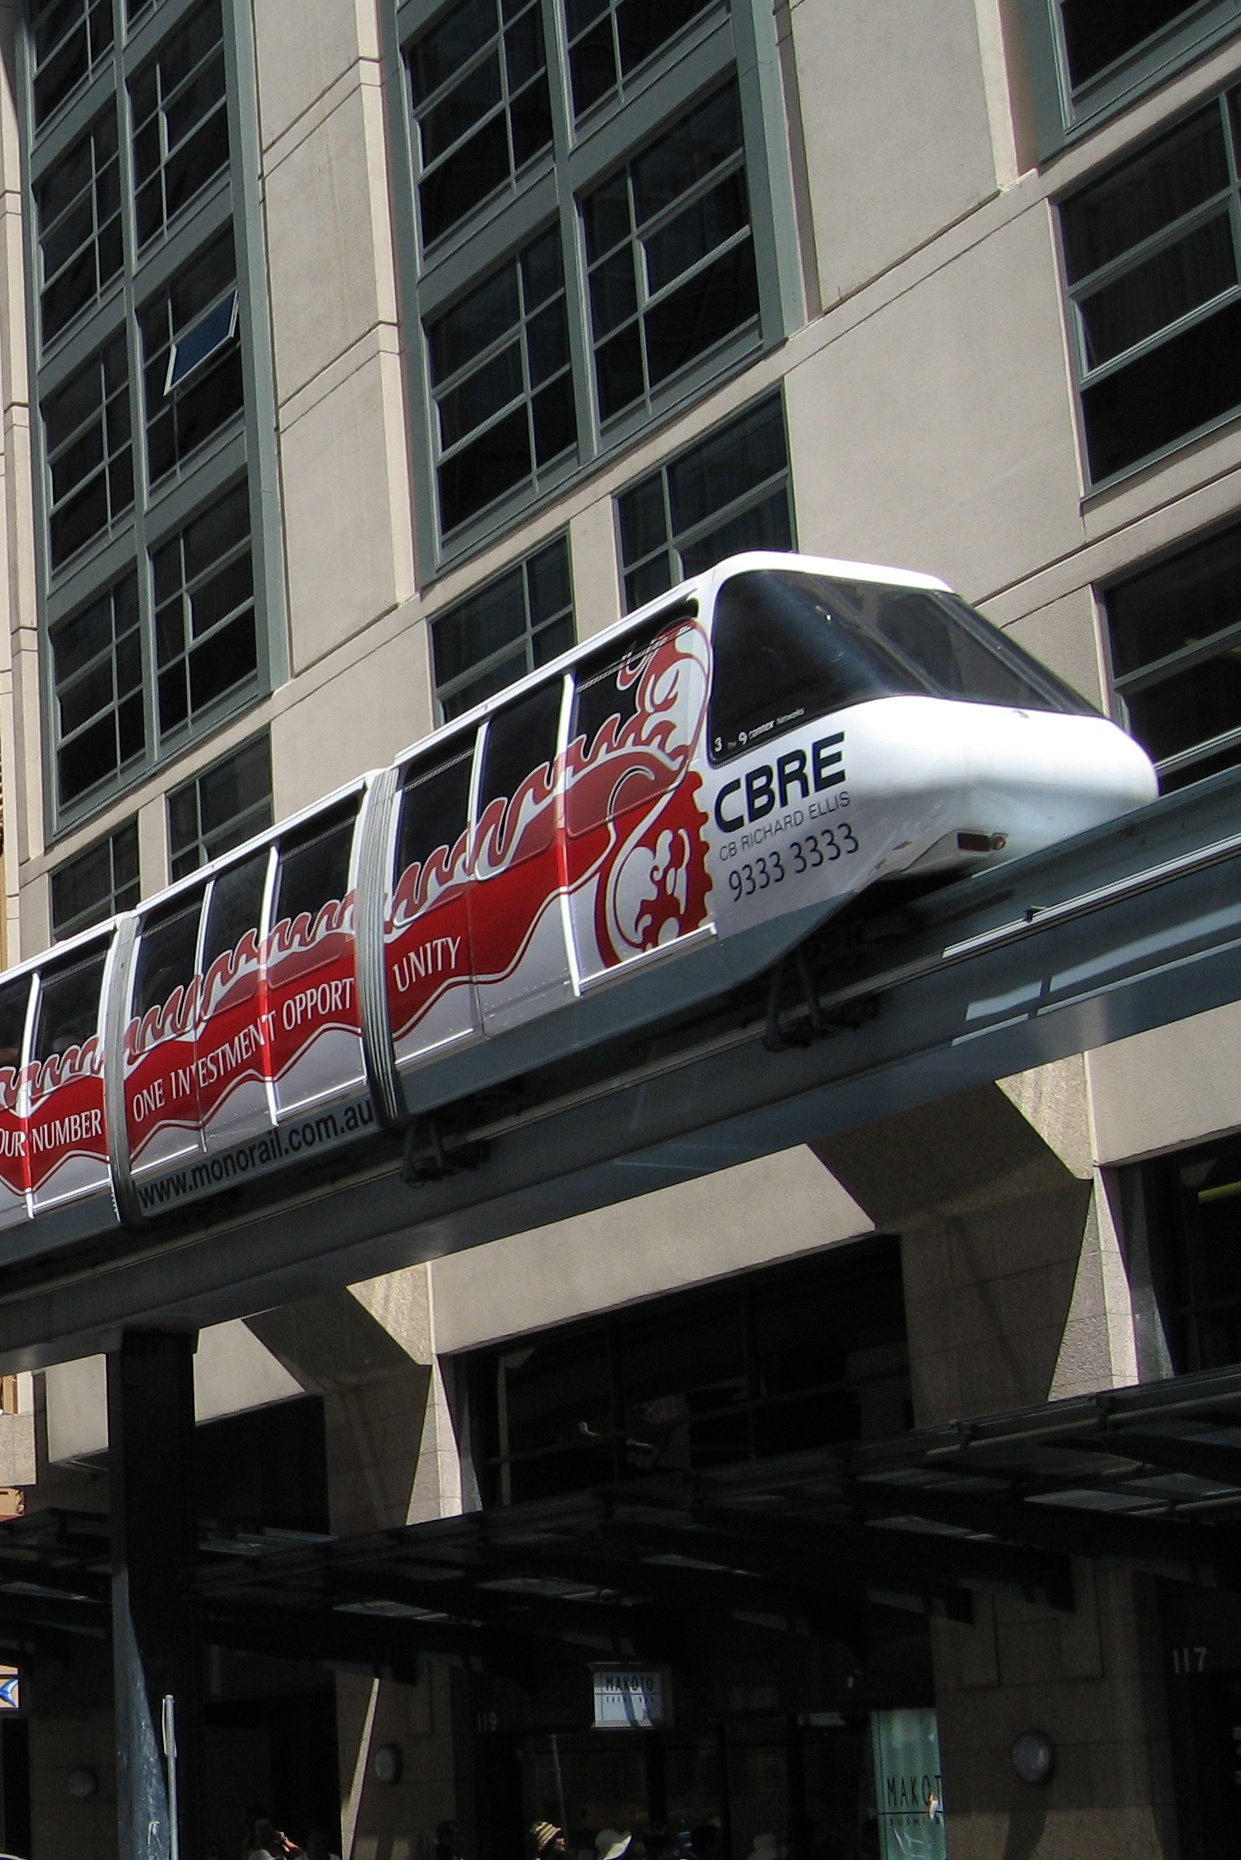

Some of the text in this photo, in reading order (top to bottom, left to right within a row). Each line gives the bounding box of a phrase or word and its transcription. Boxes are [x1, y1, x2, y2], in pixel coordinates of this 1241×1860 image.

[714, 736, 723, 752] 3
[714, 730, 846, 834] CBRE
[719, 791, 851, 862] CB RICHARD ELLIS
[728, 822, 860, 902] 9333 3333
[391, 935, 462, 993] UNITY
[132, 1077, 166, 1123] ONE
[282, 977, 356, 1031] OPPORT
[31, 1108, 103, 1154] NUMBER
[139, 1099, 375, 1209] www.monorail.com.au
[606, 1676, 654, 1692] MAKOTO
[1172, 1646, 1207, 1674] 117
